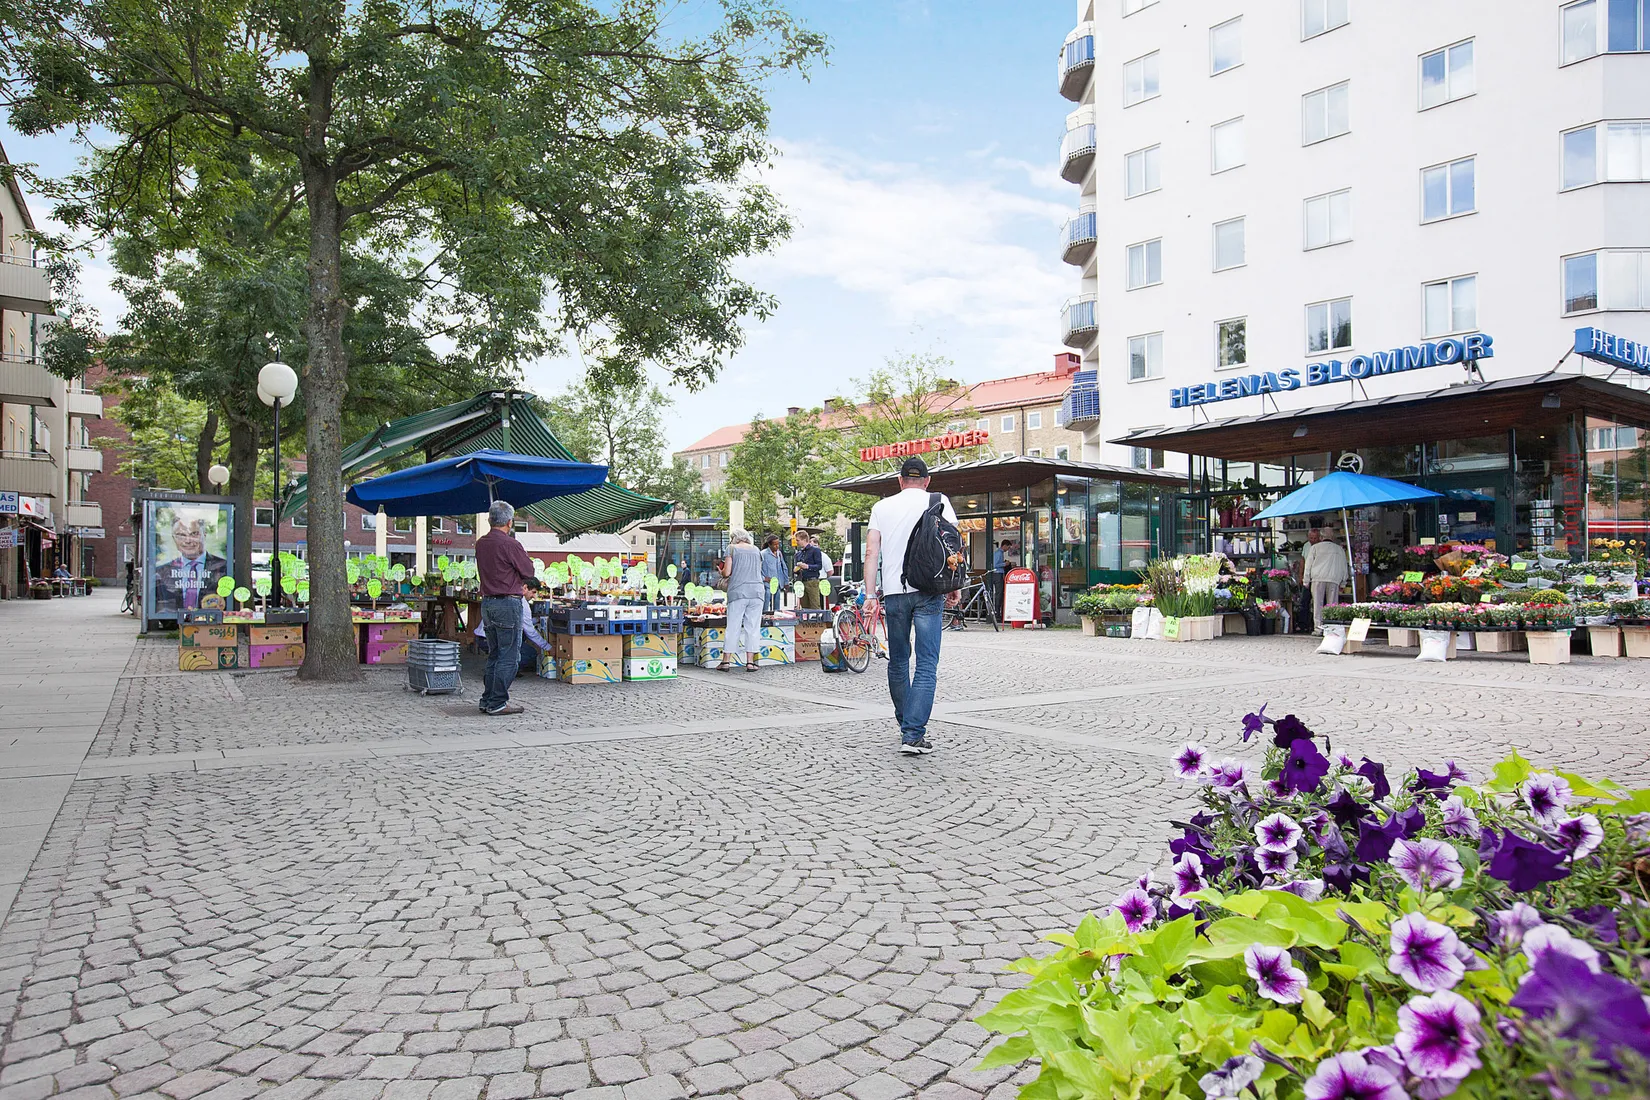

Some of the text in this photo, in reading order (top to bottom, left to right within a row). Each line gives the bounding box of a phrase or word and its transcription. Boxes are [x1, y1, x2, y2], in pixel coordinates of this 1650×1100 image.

[1170, 333, 1494, 408] HELENAS BLOMMOR
[933, 429, 989, 451] SÖDER
[171, 568, 196, 579] Rösta
[174, 579, 208, 589] skolan.
